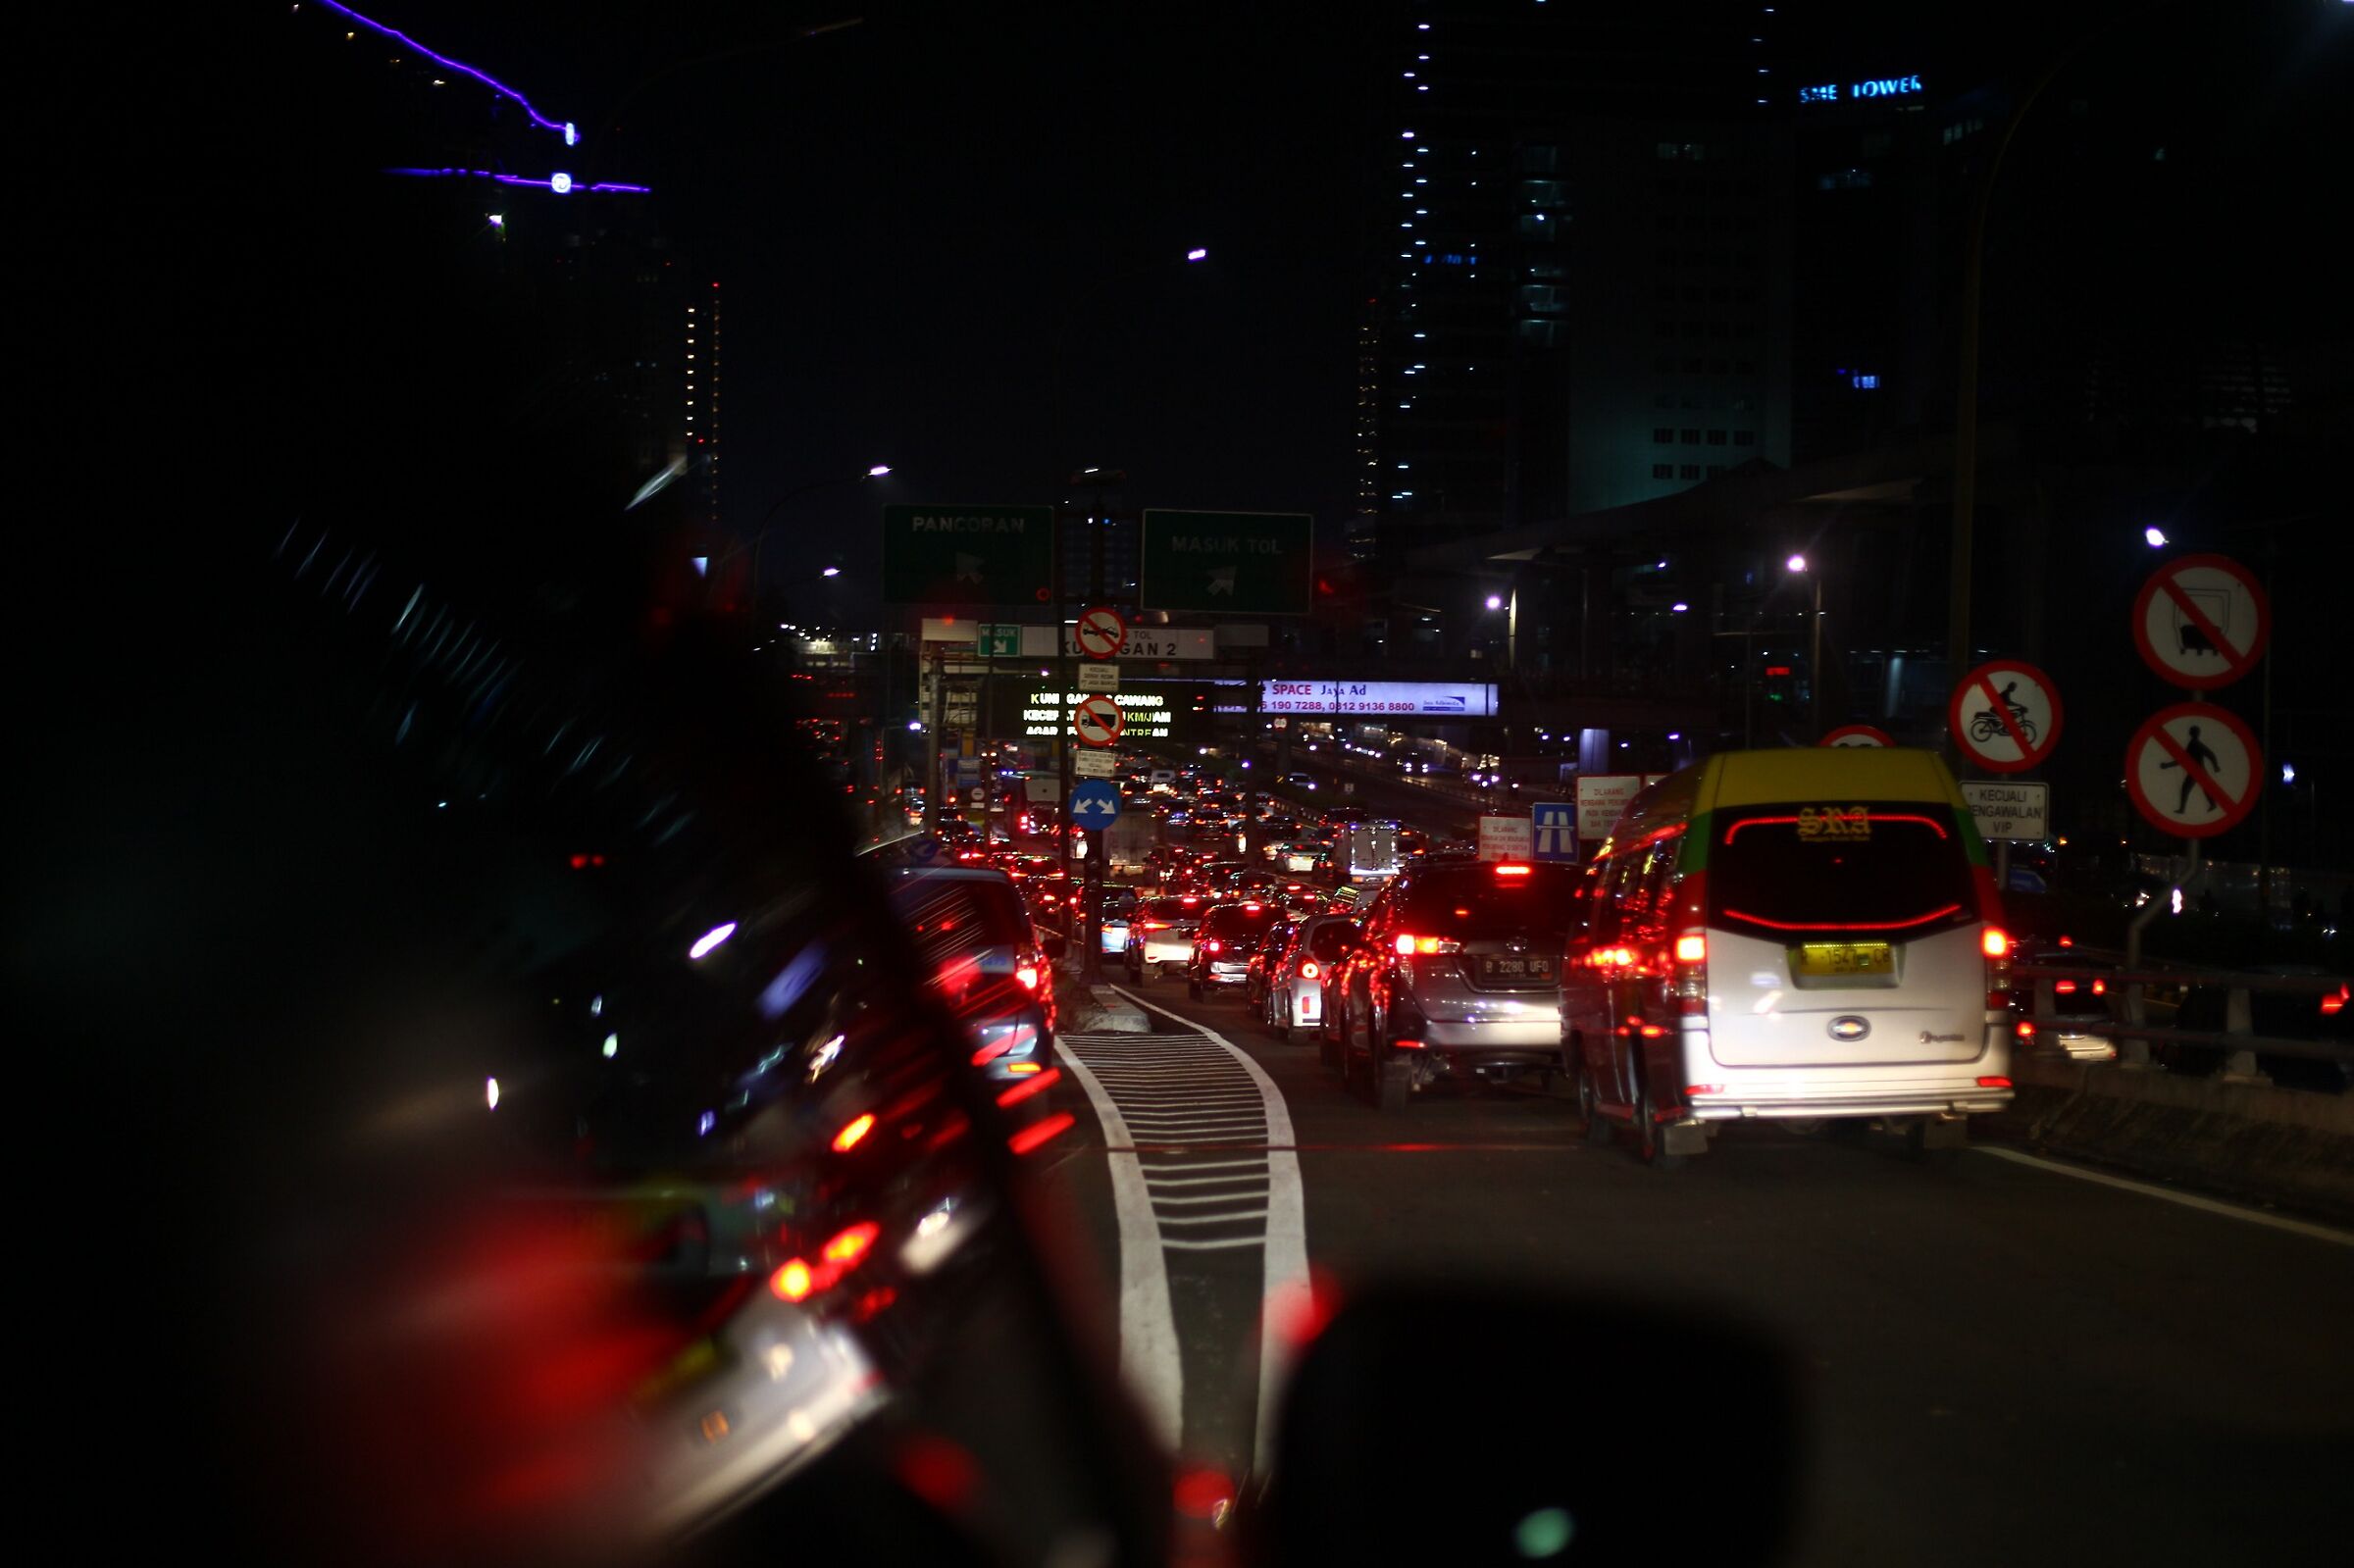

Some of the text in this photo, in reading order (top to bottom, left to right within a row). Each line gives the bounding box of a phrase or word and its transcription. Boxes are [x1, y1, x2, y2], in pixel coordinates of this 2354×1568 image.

[911, 516, 1025, 534] PANCORAN
[1172, 534, 1283, 556] MASUK TOL
[1063, 642, 1177, 656] KUGAN 2
[1272, 684, 1312, 695] SPACE
[1349, 684, 1366, 696] Ad
[1271, 700, 1292, 710] 190
[1295, 701, 1325, 712] 7288,
[1358, 703, 1385, 712] 9136
[1388, 703, 1414, 712] 8800
[1979, 788, 2027, 803] KECUALI
[1970, 804, 2041, 819] ENGAWALAN
[1993, 821, 2013, 834] VIP
